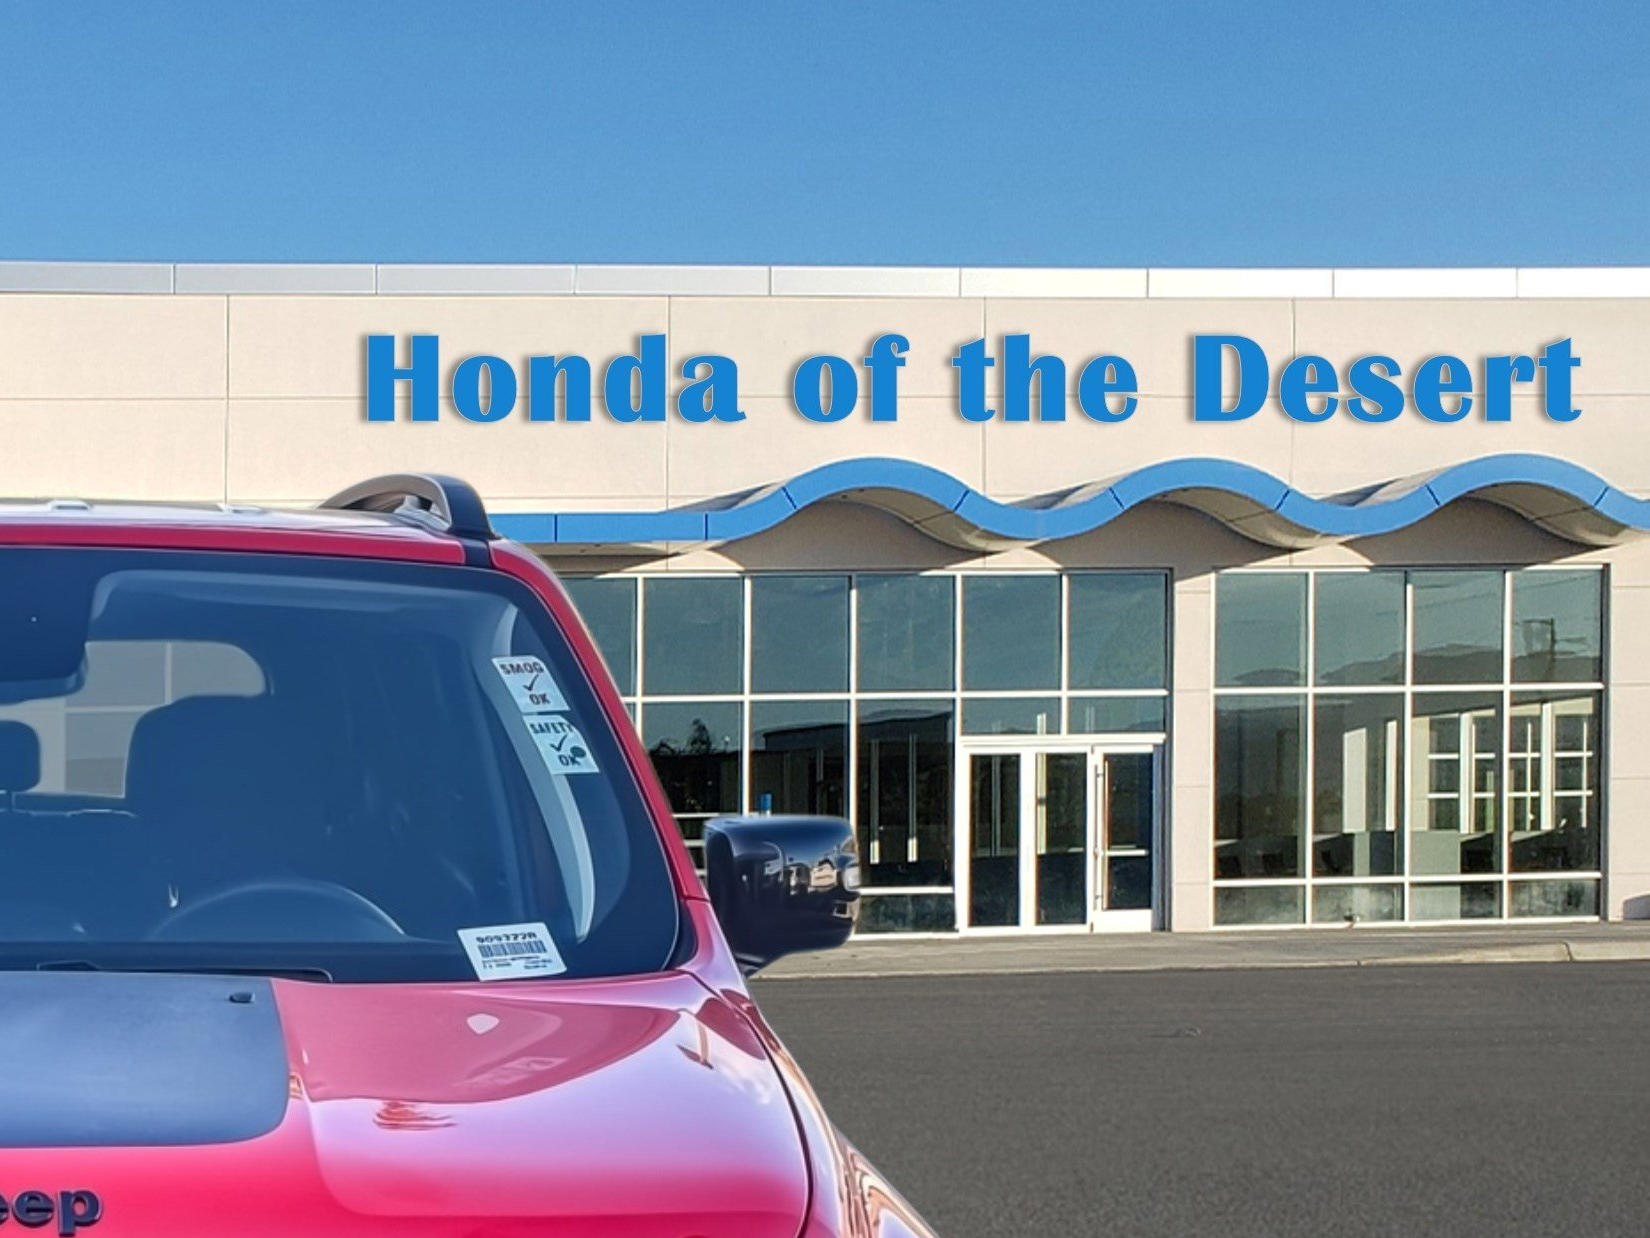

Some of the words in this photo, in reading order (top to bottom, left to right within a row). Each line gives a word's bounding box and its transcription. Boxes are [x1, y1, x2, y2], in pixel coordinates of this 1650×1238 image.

[365, 332, 748, 424] Honda
[792, 332, 912, 424] of
[951, 332, 1140, 424] the
[1193, 333, 1583, 424] Desert
[499, 661, 545, 675] SMOG
[528, 693, 551, 706] OK
[557, 753, 582, 767] OK
